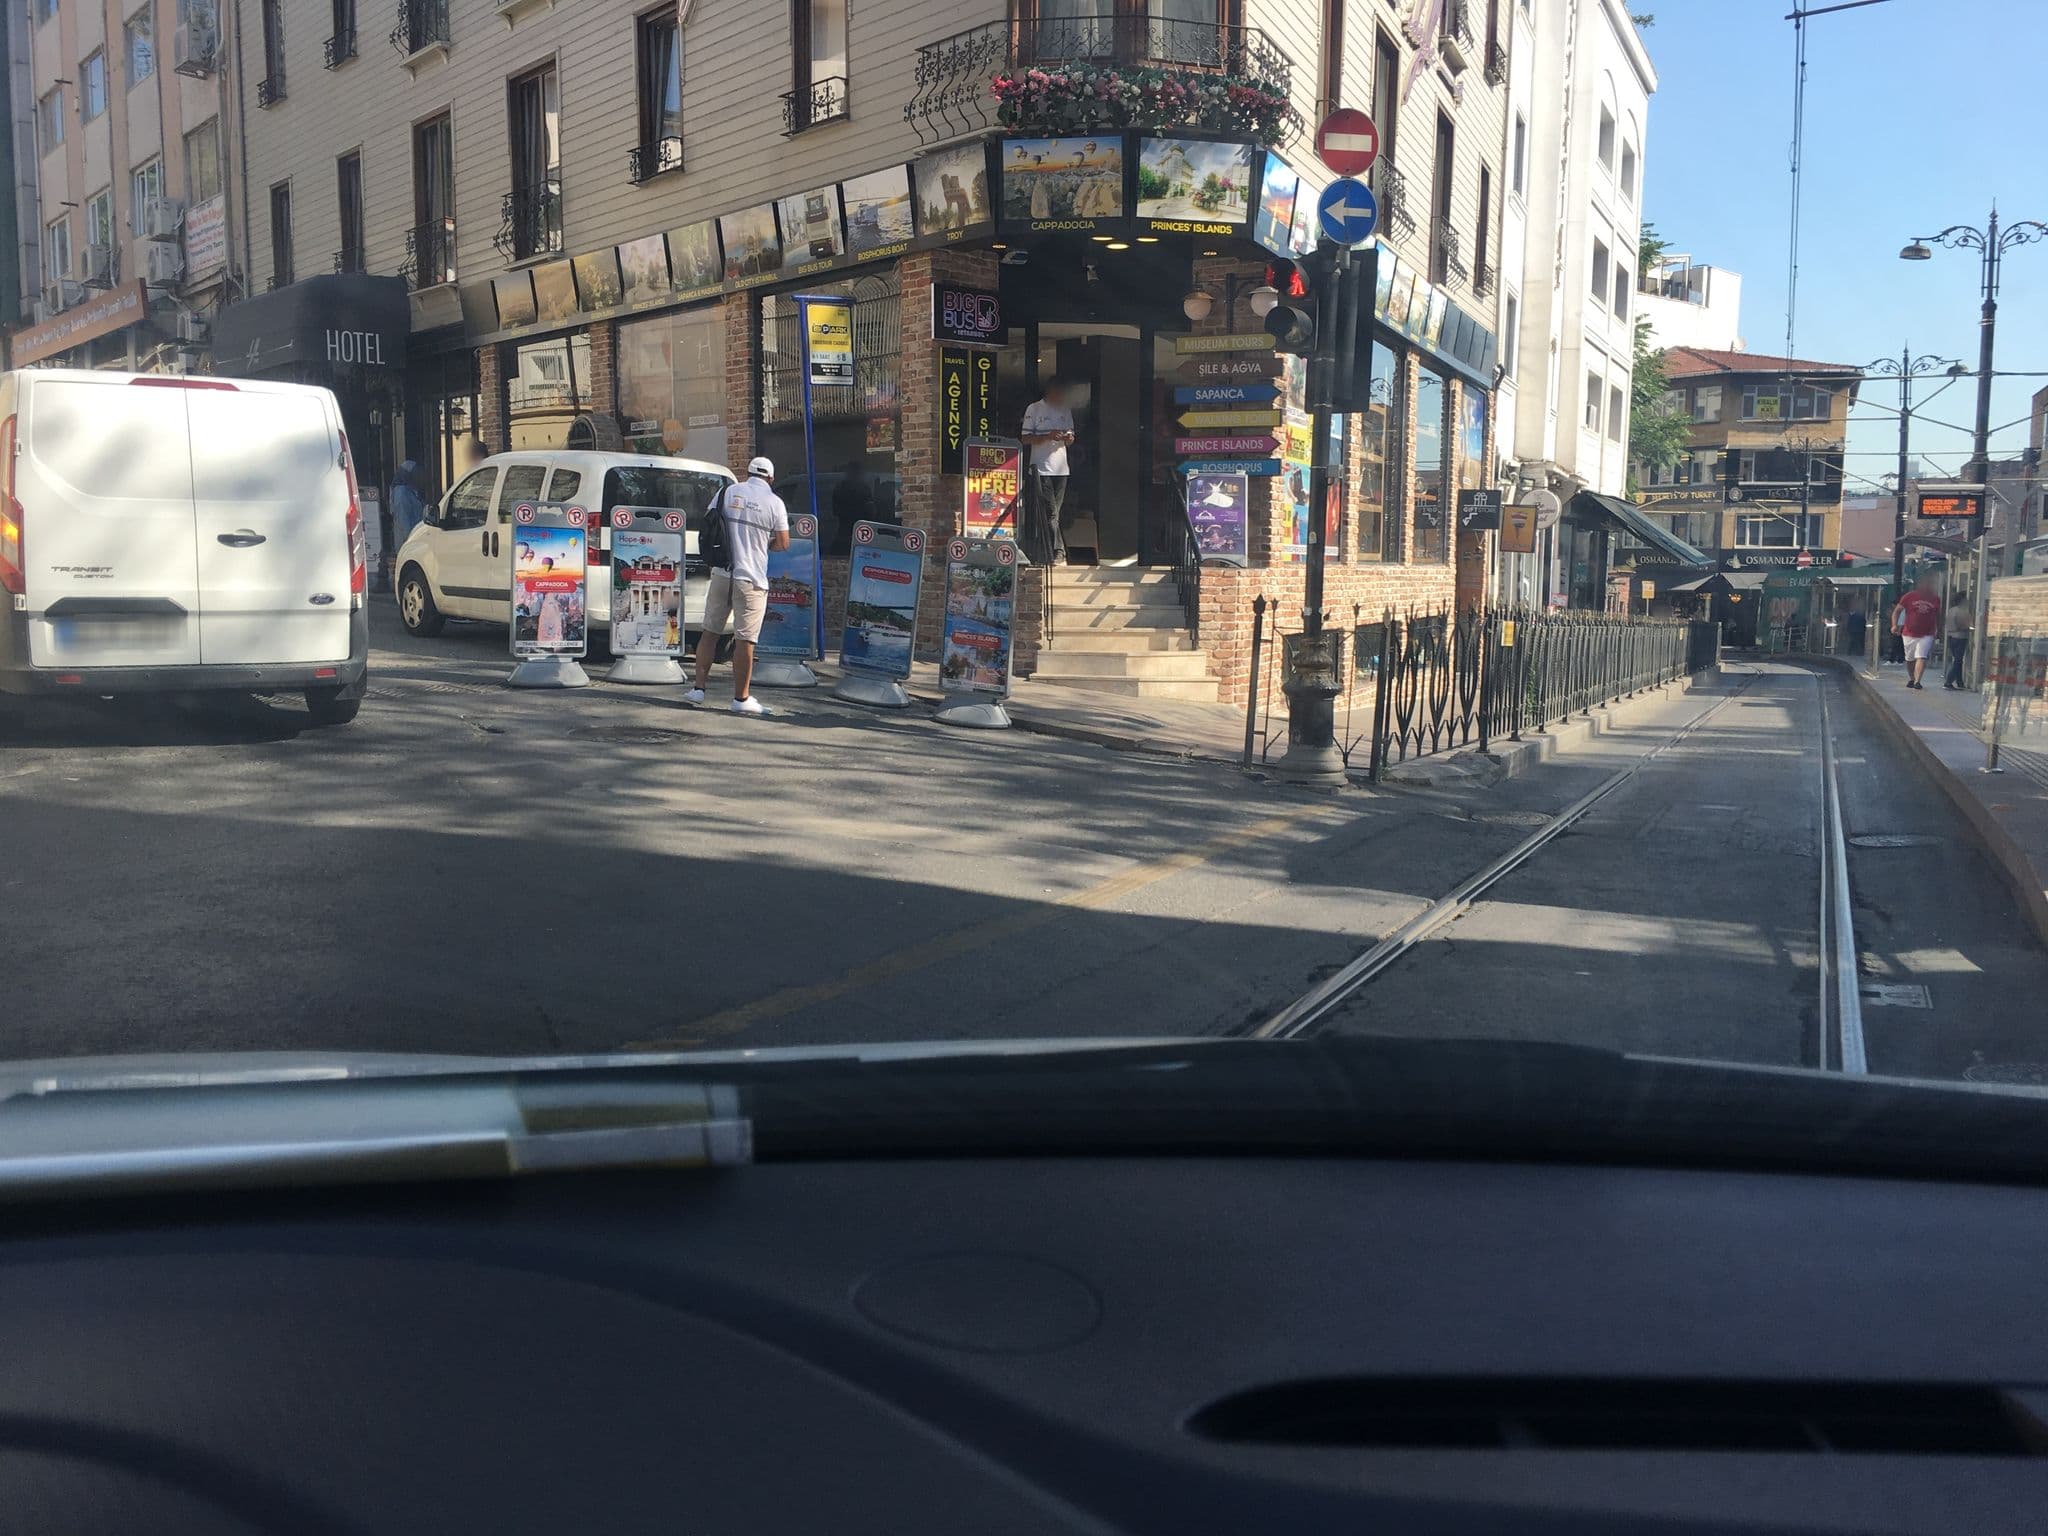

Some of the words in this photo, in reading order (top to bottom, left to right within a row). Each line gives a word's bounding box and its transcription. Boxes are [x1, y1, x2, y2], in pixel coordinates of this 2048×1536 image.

[1031, 220, 1096, 231] CAPPADOCIA
[1151, 221, 1192, 233] PRINCES'
[1193, 223, 1233, 235] ISLANDS
[946, 230, 964, 240] TROY
[857, 247, 892, 261] BOSPHORUS
[892, 243, 908, 254] BOAT
[943, 290, 975, 312] BIG
[943, 310, 975, 330] BUS
[326, 328, 386, 365] HOTEL
[1184, 338, 1228, 350] MUSEUM
[1231, 337, 1264, 348] TOURS
[944, 357, 965, 365] TRAVEL
[1221, 363, 1229, 374] &
[1231, 361, 1262, 374] AĞVA
[978, 357, 991, 409] GIFT
[1195, 388, 1245, 400] SAPANCA
[948, 371, 961, 450] AGENCY
[1182, 440, 1219, 451] PRINCE
[1221, 439, 1264, 450] ISLANDS
[1202, 462, 1263, 473] BOSPHORUS
[985, 470, 1017, 480] TICKETS
[968, 478, 1017, 495] HERE
[1745, 556, 1832, 565] OSMANLIZELER
